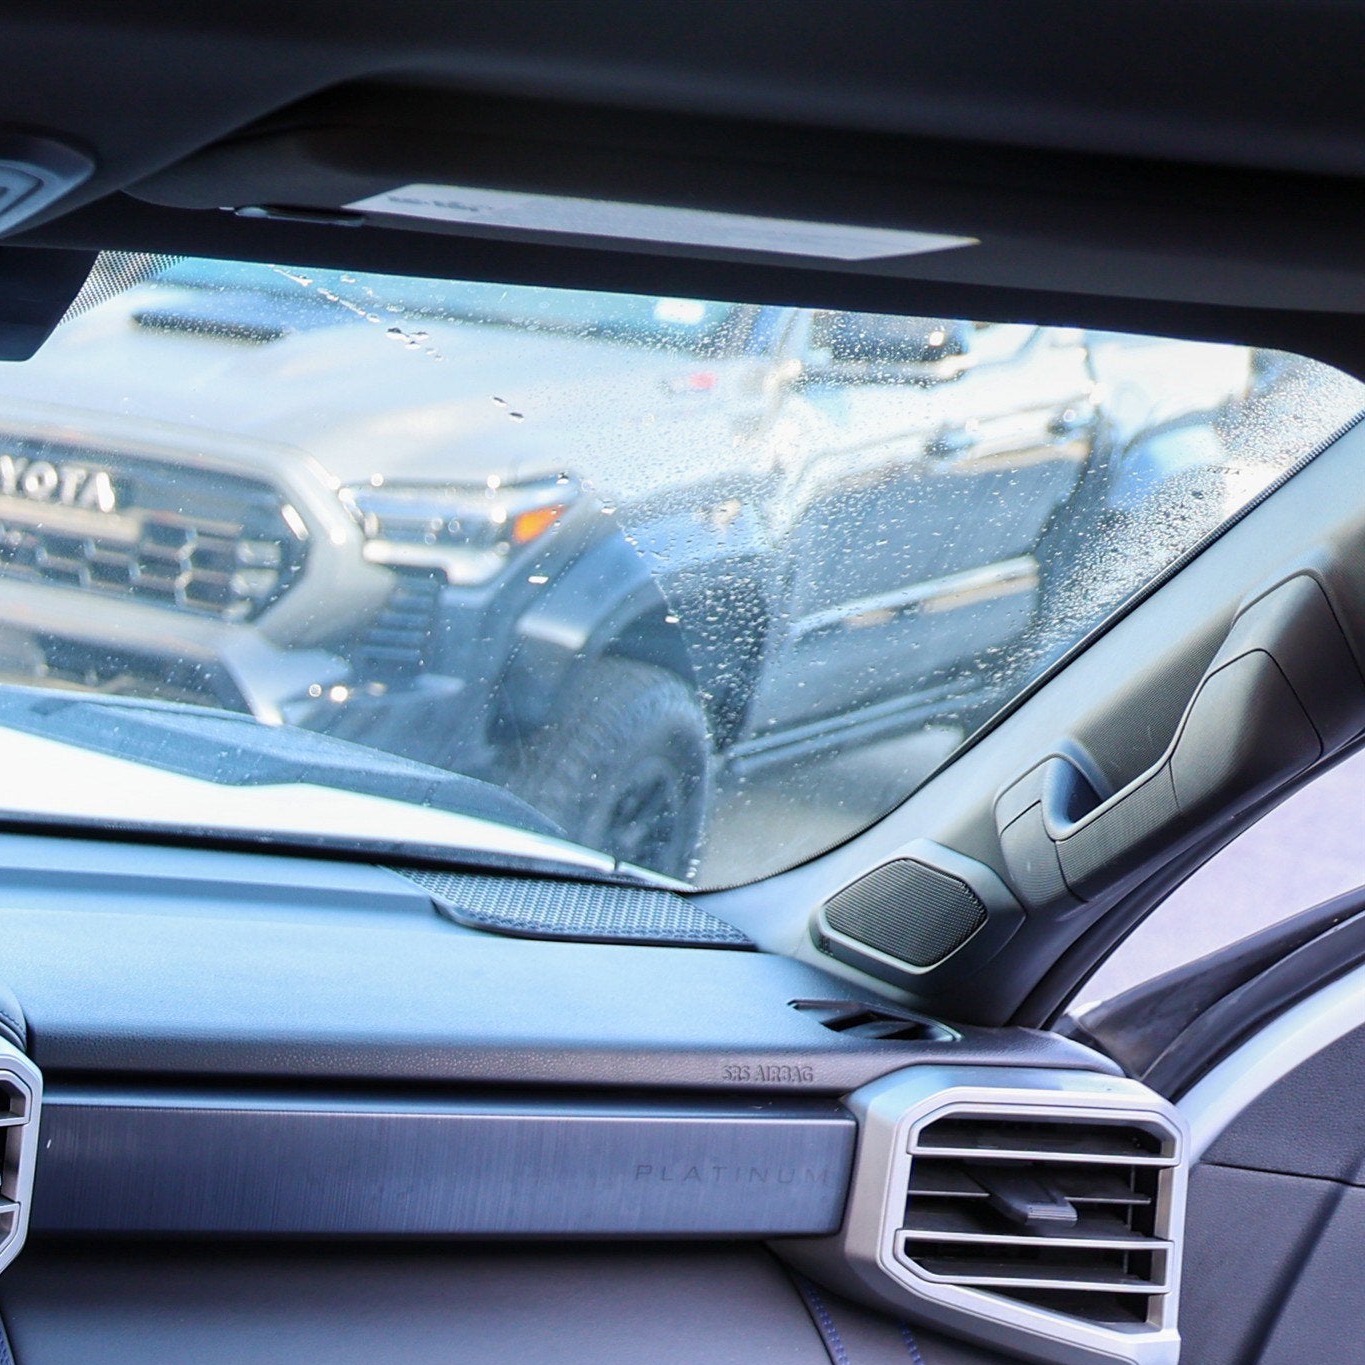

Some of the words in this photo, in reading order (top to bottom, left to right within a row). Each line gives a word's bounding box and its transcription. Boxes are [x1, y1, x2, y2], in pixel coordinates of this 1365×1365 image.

[722, 1065, 750, 1081] SRS
[755, 1064, 814, 1082] AIRBAG
[634, 1165, 831, 1184] PLATINUM
